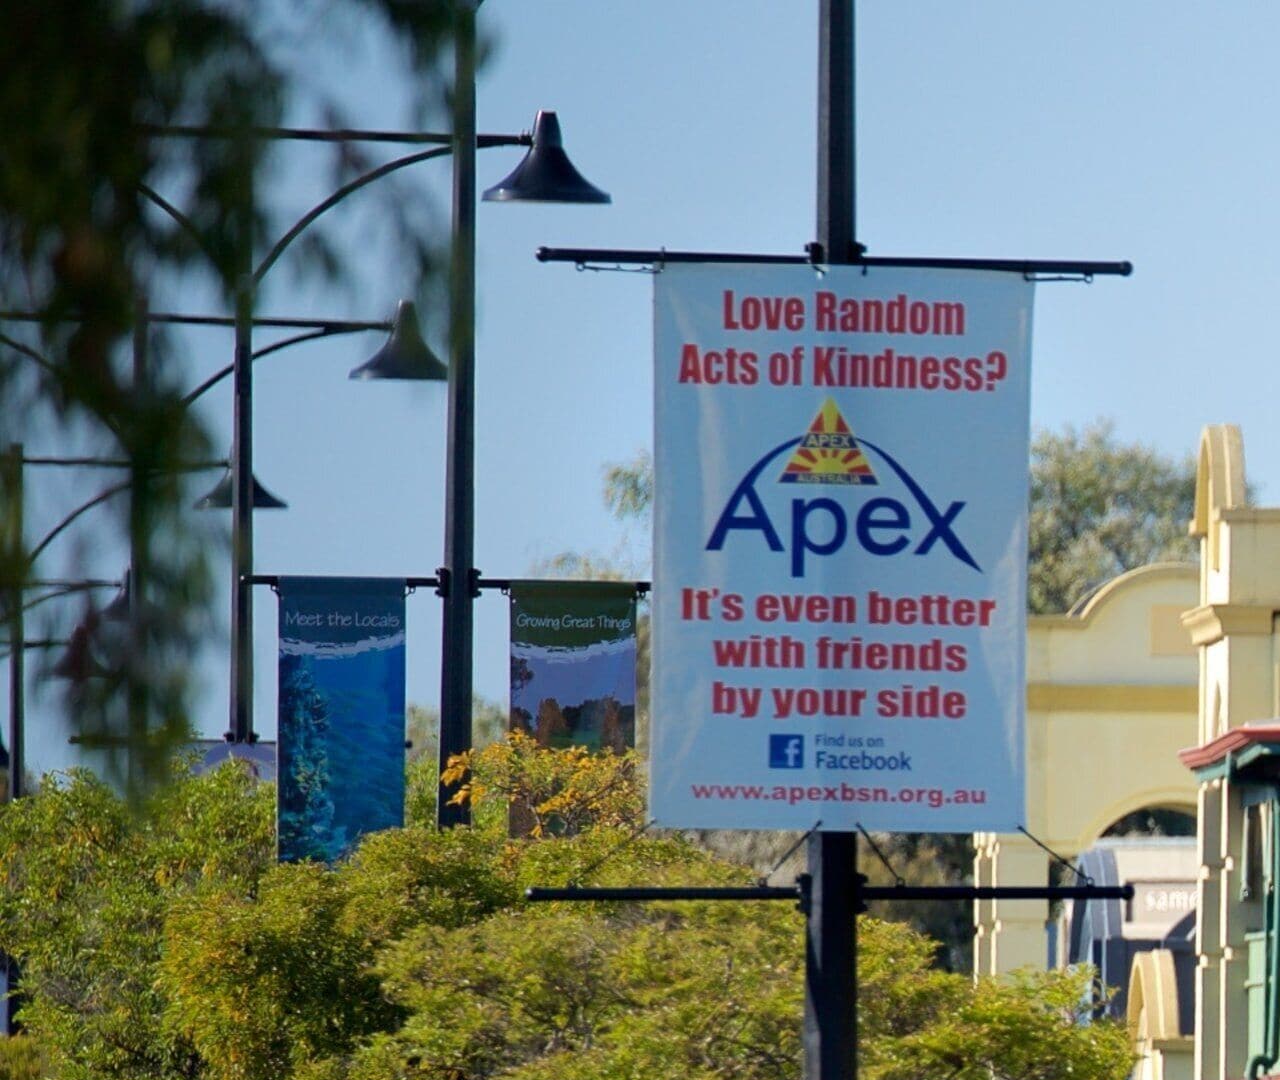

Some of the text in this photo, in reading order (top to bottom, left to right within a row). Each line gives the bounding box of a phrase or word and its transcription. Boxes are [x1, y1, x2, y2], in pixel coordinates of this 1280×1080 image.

[724, 290, 965, 335] Love Random
[679, 345, 1007, 392] Acts of Kindness?
[807, 434, 851, 448] APEX
[705, 480, 983, 577] Apex
[286, 611, 400, 628] Meet the Locals
[517, 614, 632, 630] Growing Great Things
[682, 588, 996, 627] It's even better
[713, 635, 967, 672] with friends
[712, 681, 966, 719] by your side
[815, 734, 884, 748] Find us on
[815, 751, 912, 771] Facebook
[692, 783, 986, 807] www.apexbsn.org.au
